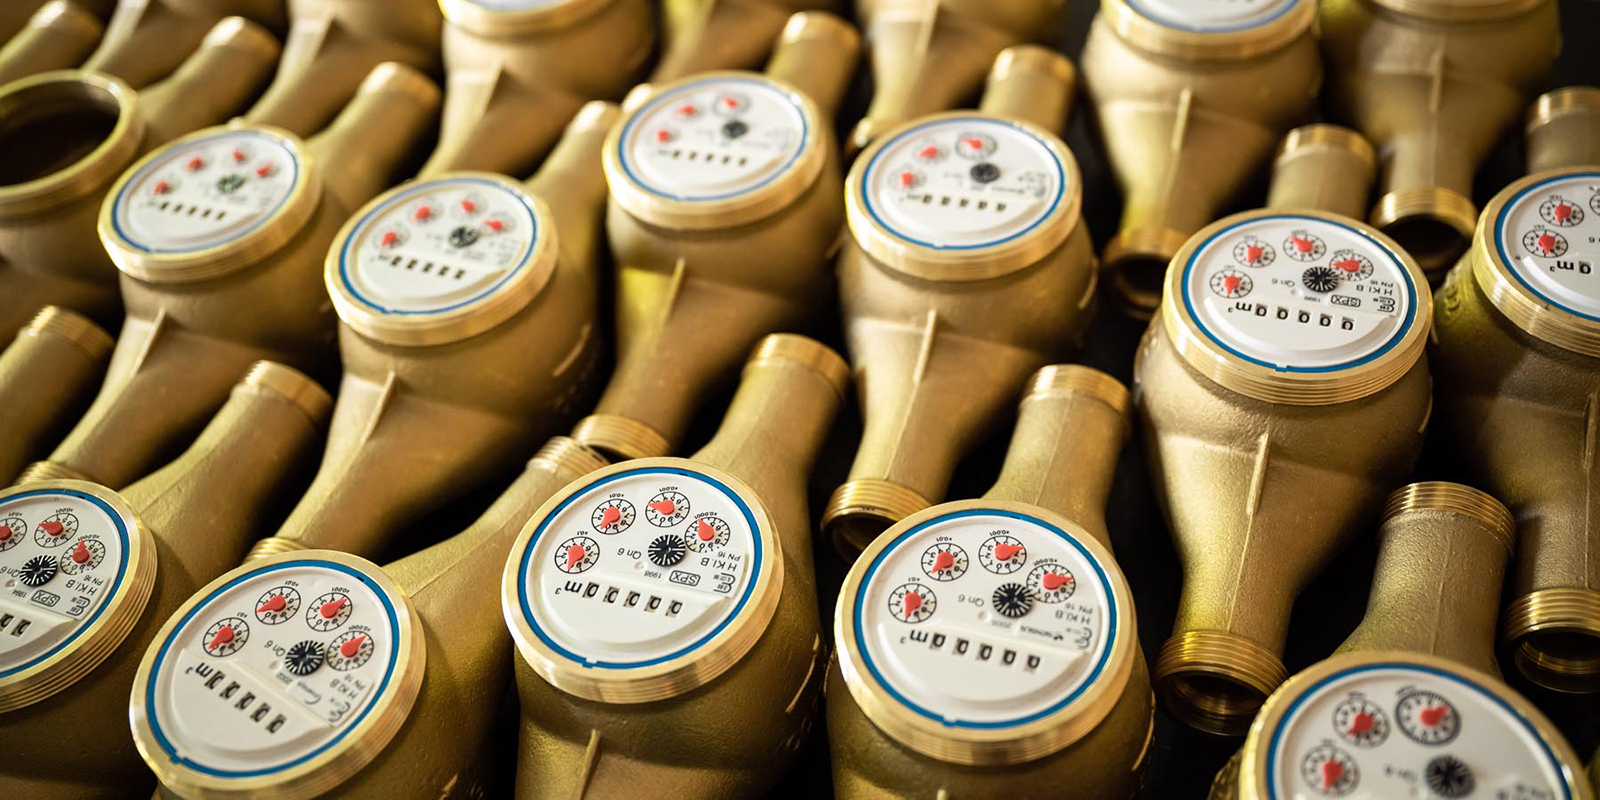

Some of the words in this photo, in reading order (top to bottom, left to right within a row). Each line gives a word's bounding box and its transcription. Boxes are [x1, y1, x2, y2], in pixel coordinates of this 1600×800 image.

[1334, 296, 1358, 306] SPX
[627, 550, 641, 559] Qn
[728, 553, 741, 561] PN
[728, 563, 737, 571] H
[7, 568, 20, 577] Qn
[672, 572, 698, 585] SPX
[87, 587, 97, 596] H
[34, 591, 57, 604] SPX
[958, 594, 965, 602] 6
[969, 597, 985, 607] Qn
[264, 640, 273, 648] 6
